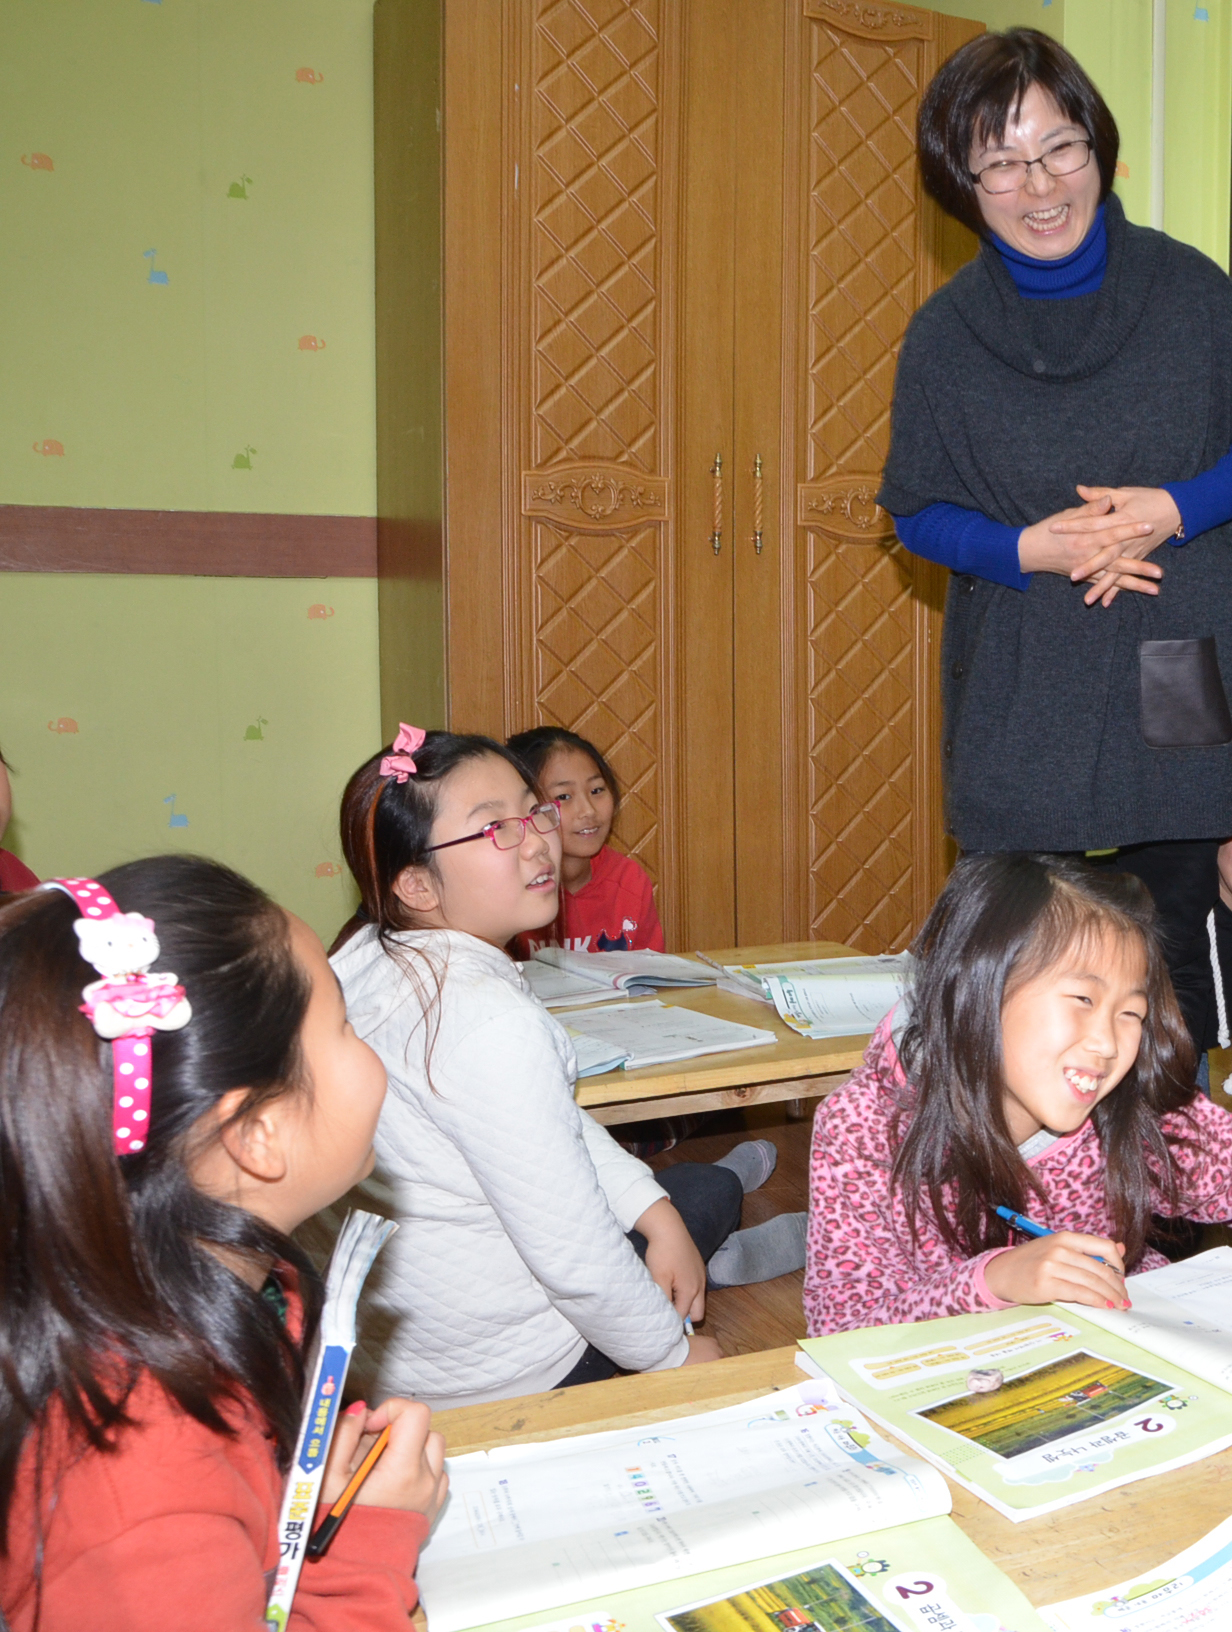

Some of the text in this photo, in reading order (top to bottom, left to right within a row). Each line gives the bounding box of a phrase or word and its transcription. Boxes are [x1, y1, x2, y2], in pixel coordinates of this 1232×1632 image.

[1134, 1417, 1164, 1432] 2
[1041, 1430, 1132, 1464] 곱셈과 나눗셈
[895, 1580, 935, 1600] 2
